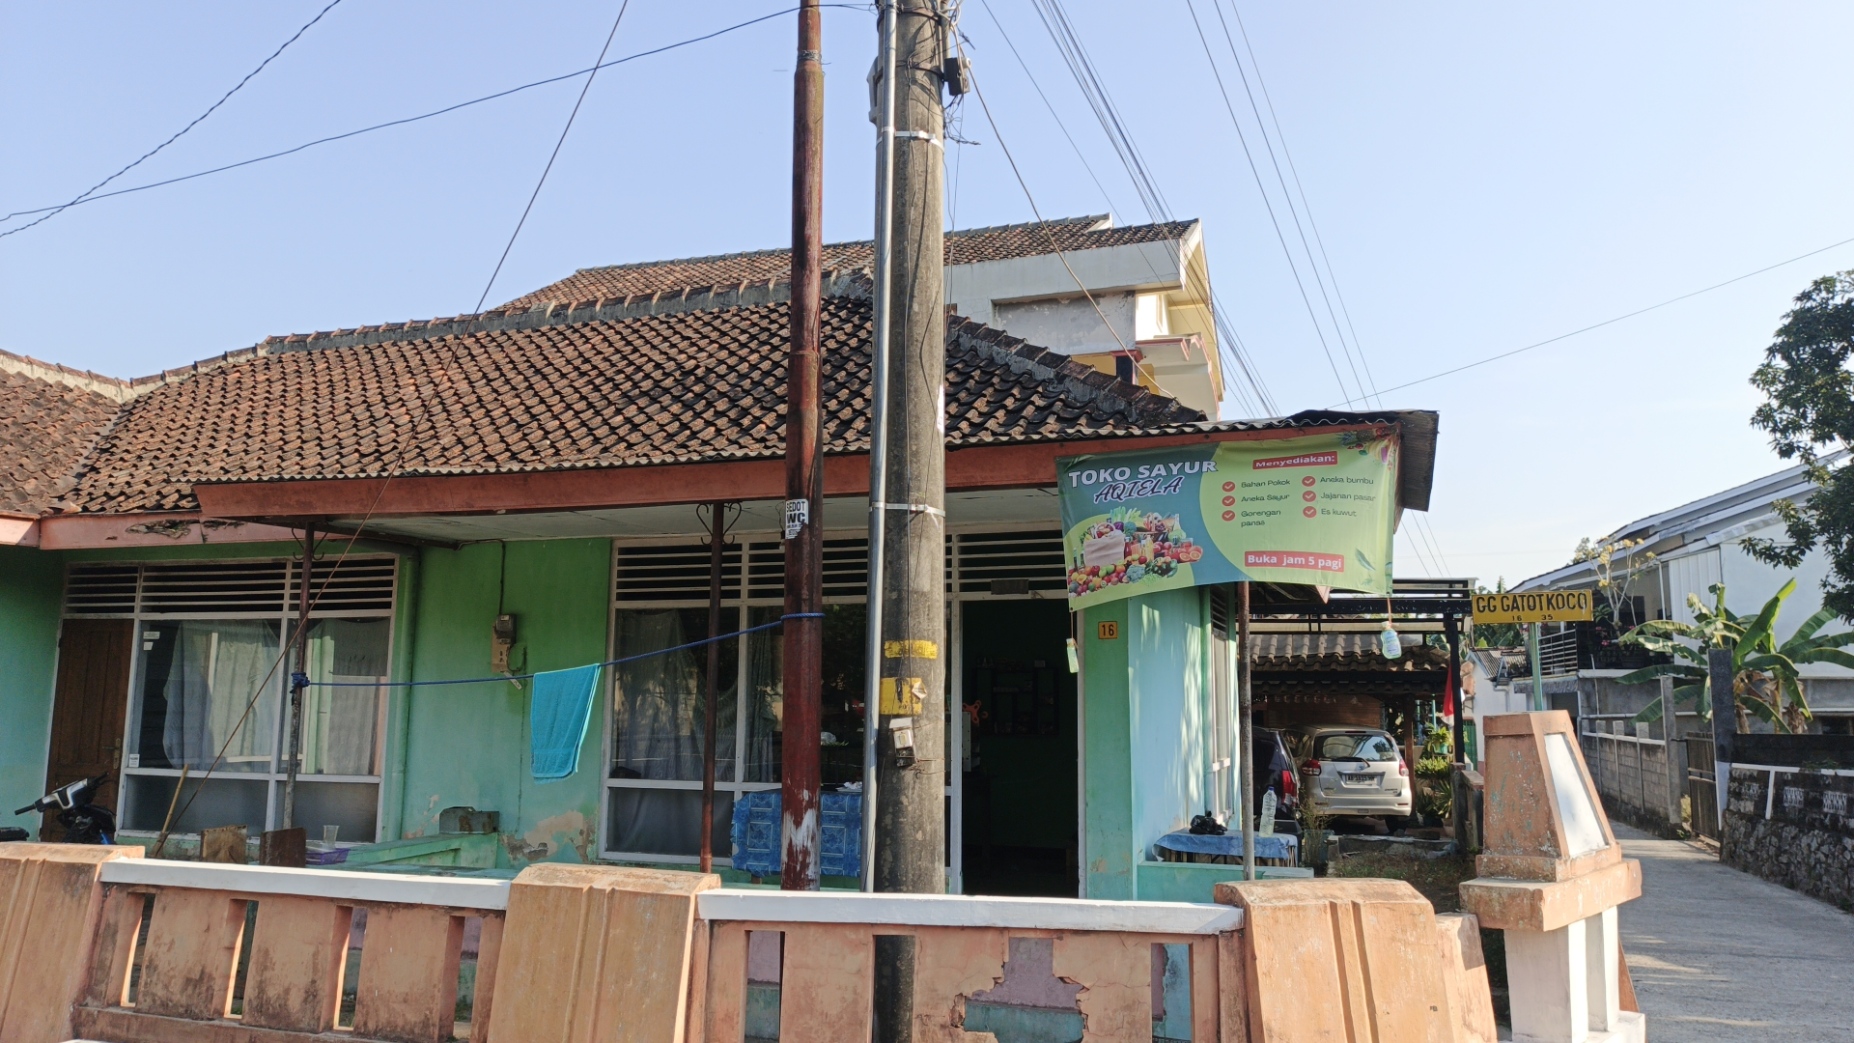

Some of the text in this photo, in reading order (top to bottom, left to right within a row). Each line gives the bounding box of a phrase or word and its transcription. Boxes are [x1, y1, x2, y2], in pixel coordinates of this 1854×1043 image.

[1255, 455, 1335, 467] Menyediakan:
[1068, 461, 1218, 487] TOKO SAYUR
[1241, 479, 1291, 489] Bahan Pokok
[1320, 476, 1374, 485] Aneka bumbu
[1094, 475, 1185, 504] AQIELA
[1241, 493, 1290, 503] Aneka Sayur
[1320, 492, 1377, 503] Jajanan pasar
[787, 512, 805, 523] WC
[1241, 510, 1281, 518] Gorengan
[1321, 508, 1332, 516] Es
[1241, 520, 1265, 528] panas
[1247, 554, 1343, 570] Buka jam 5 pagi
[1476, 593, 1587, 613] GG GATOTKOCO
[1101, 624, 1115, 636] 16
